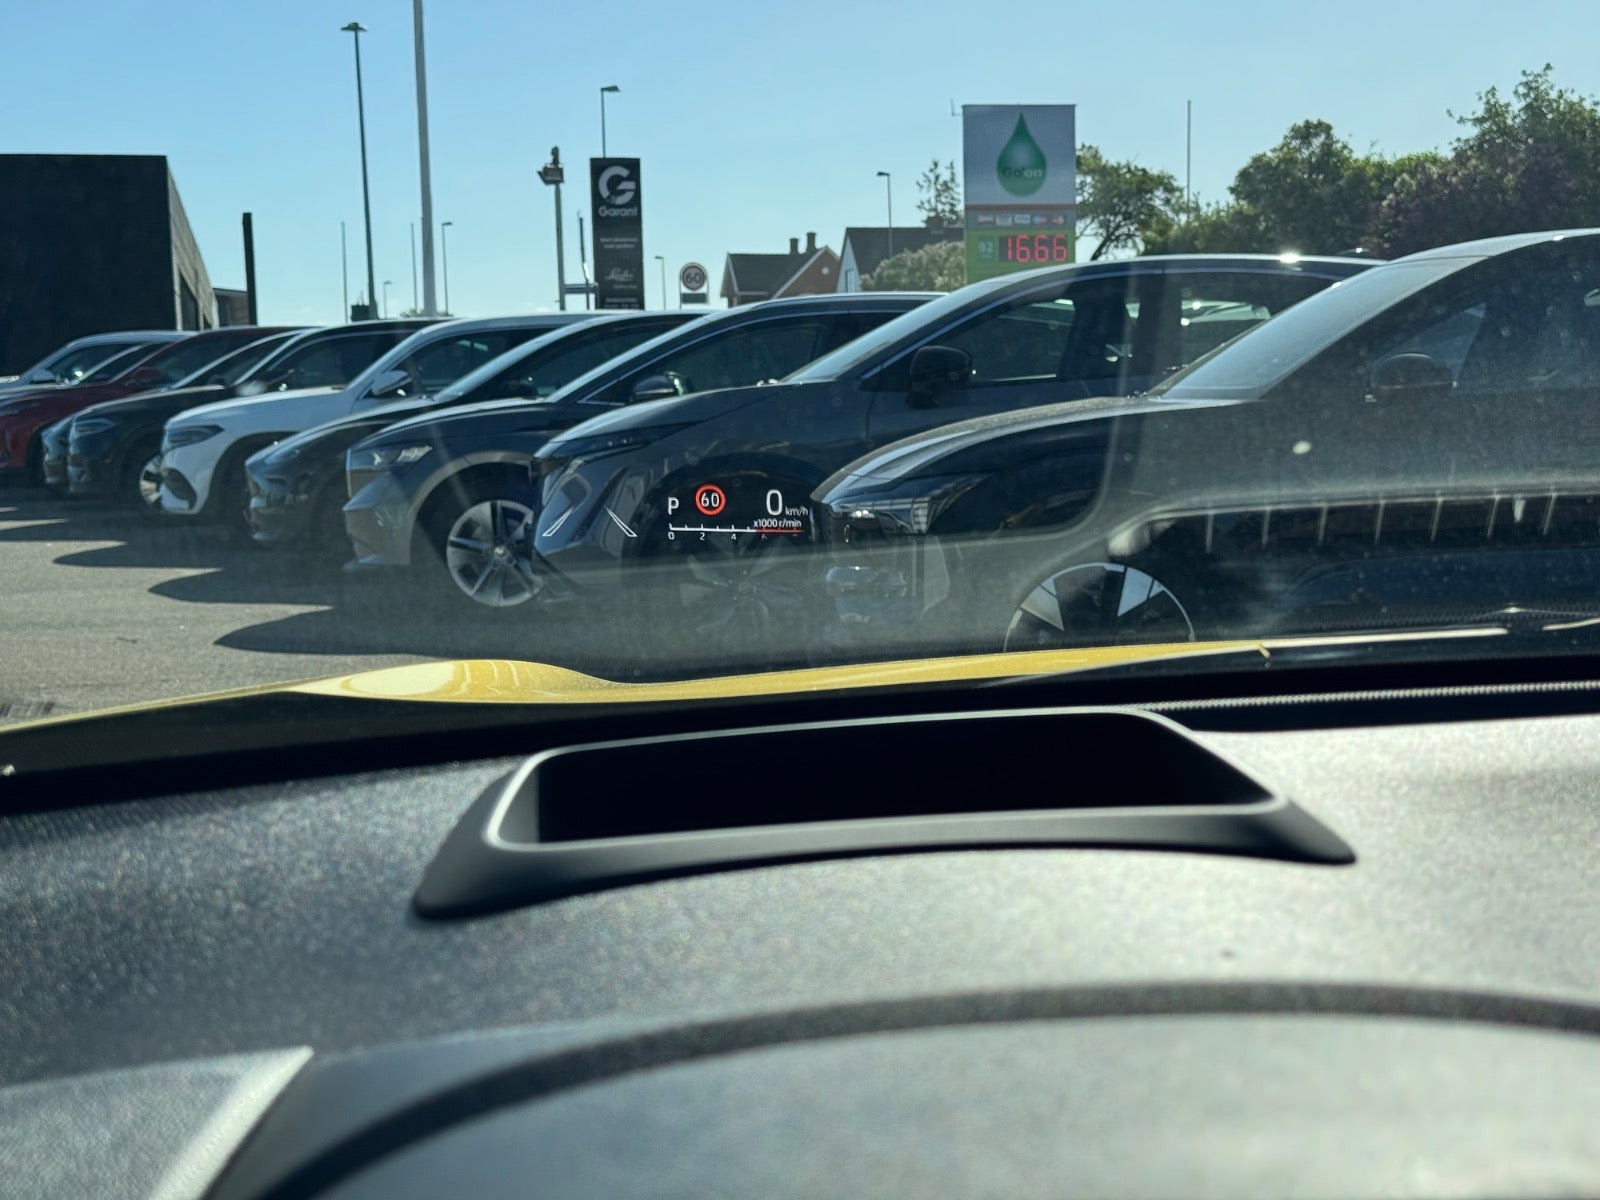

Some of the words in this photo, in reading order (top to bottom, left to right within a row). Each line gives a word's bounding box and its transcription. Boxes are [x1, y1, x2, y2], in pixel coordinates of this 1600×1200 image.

[598, 206, 638, 218] Garant
[686, 272, 701, 284] 60
[667, 496, 679, 515] P
[701, 492, 720, 508] 60
[766, 489, 783, 516] 0
[785, 506, 809, 517] km/h
[753, 518, 778, 528] x1000
[778, 518, 802, 528] r/min
[668, 533, 675, 541] 0
[700, 532, 705, 541] 2
[731, 533, 737, 541] 4
